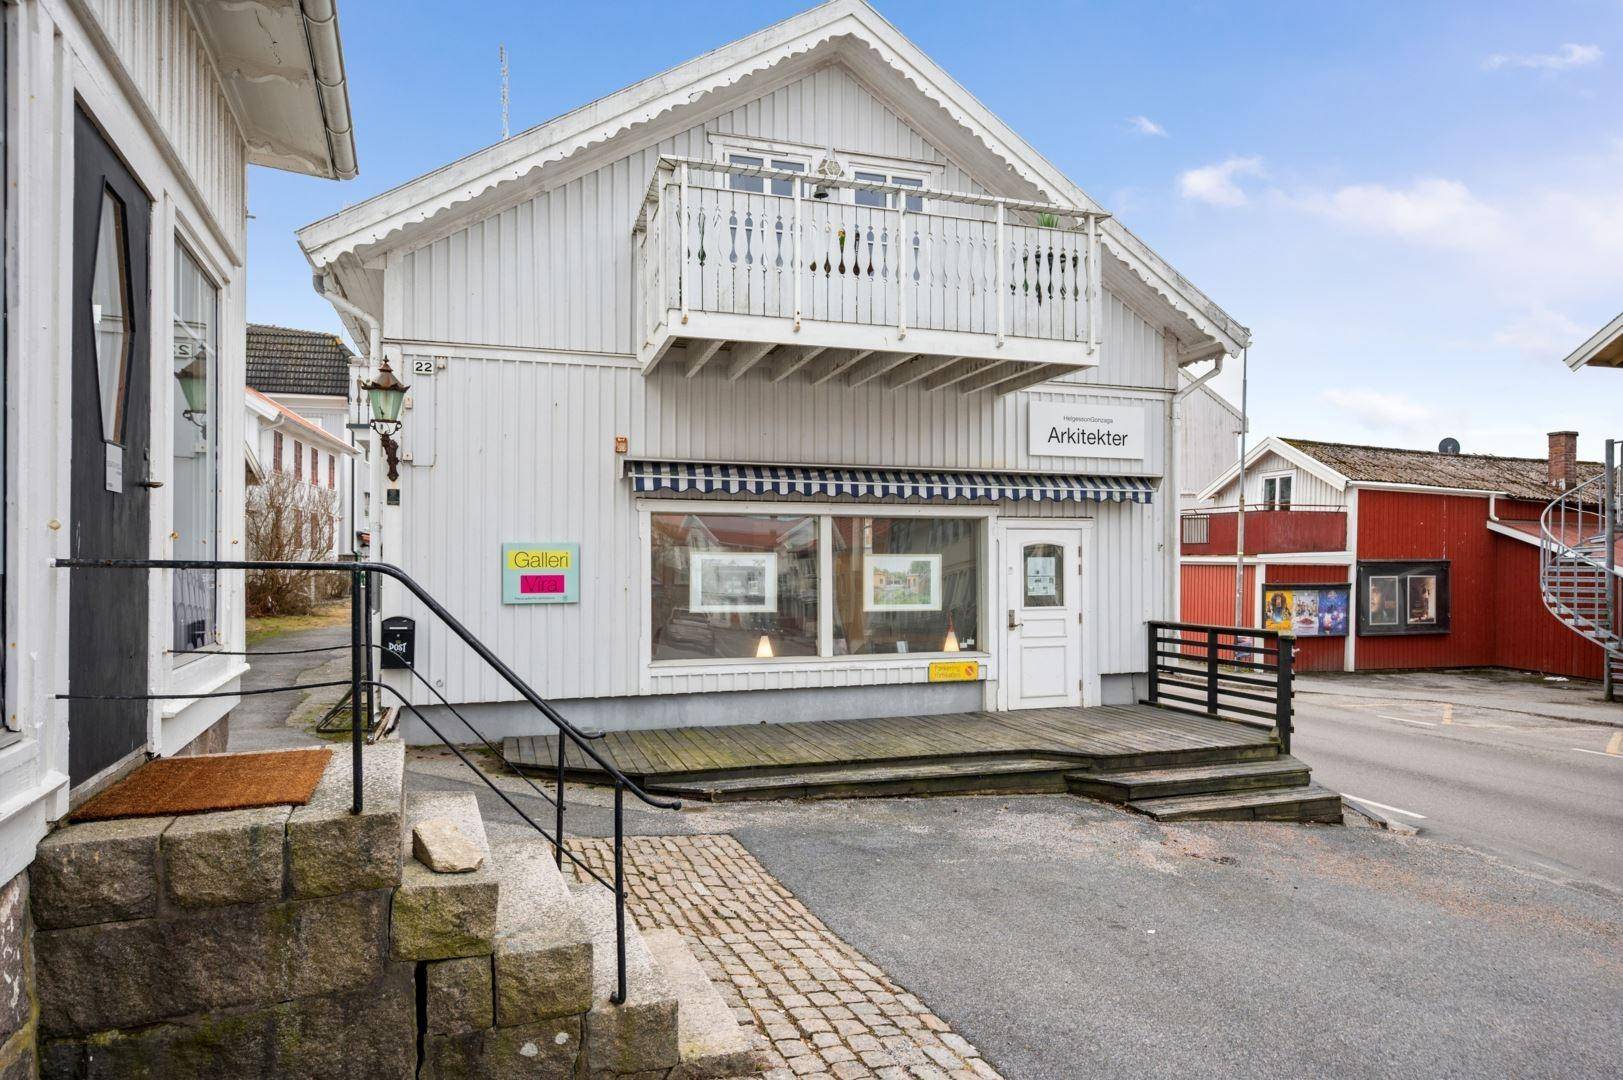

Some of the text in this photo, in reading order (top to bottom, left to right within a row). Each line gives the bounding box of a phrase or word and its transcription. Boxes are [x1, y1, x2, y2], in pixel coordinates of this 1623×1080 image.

[415, 361, 432, 372] 22
[1047, 426, 1129, 447] Arkitekter
[514, 551, 569, 568] Galleri
[388, 641, 407, 653] POST
